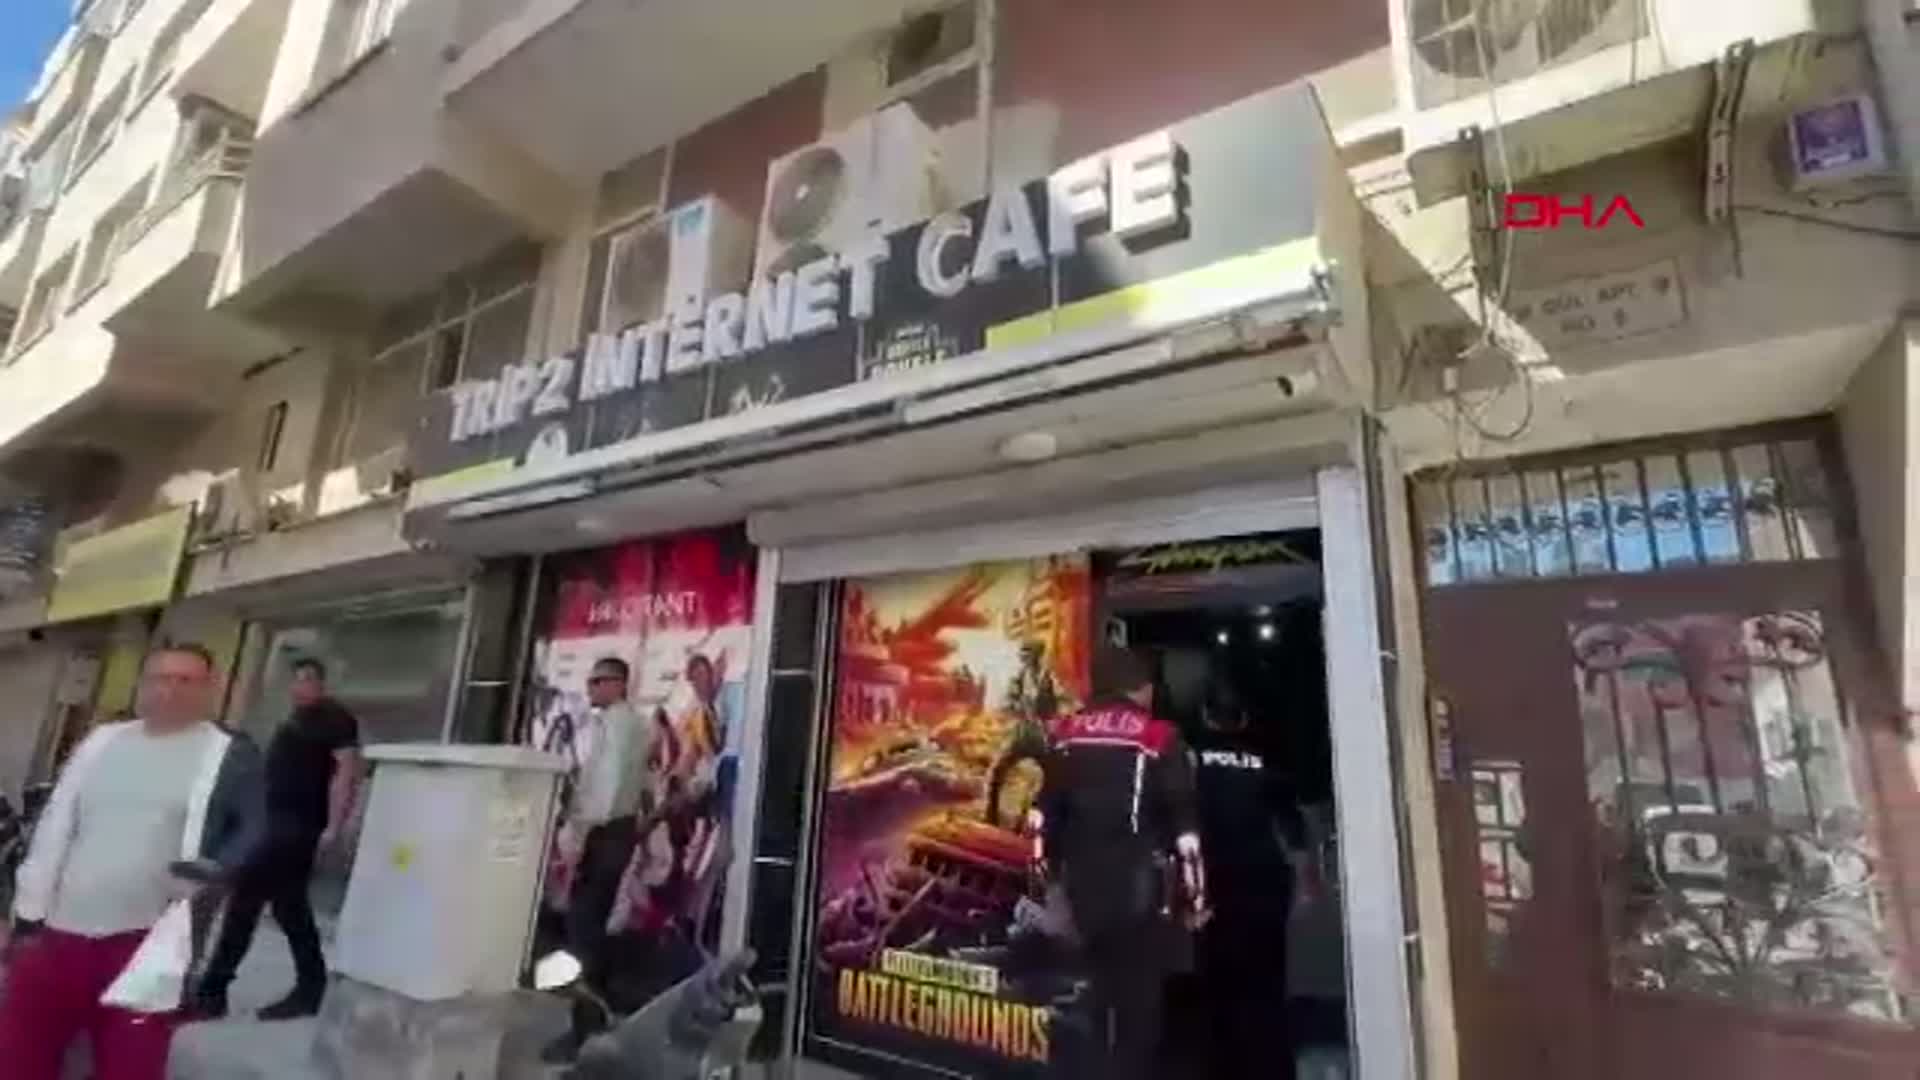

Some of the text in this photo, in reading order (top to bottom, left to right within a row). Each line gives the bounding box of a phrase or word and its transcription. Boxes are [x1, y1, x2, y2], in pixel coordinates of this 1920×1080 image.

[578, 230, 892, 401] INTERNET
[917, 131, 1178, 297] CAFE
[838, 968, 1050, 1064] BATTLEGROUNDS
